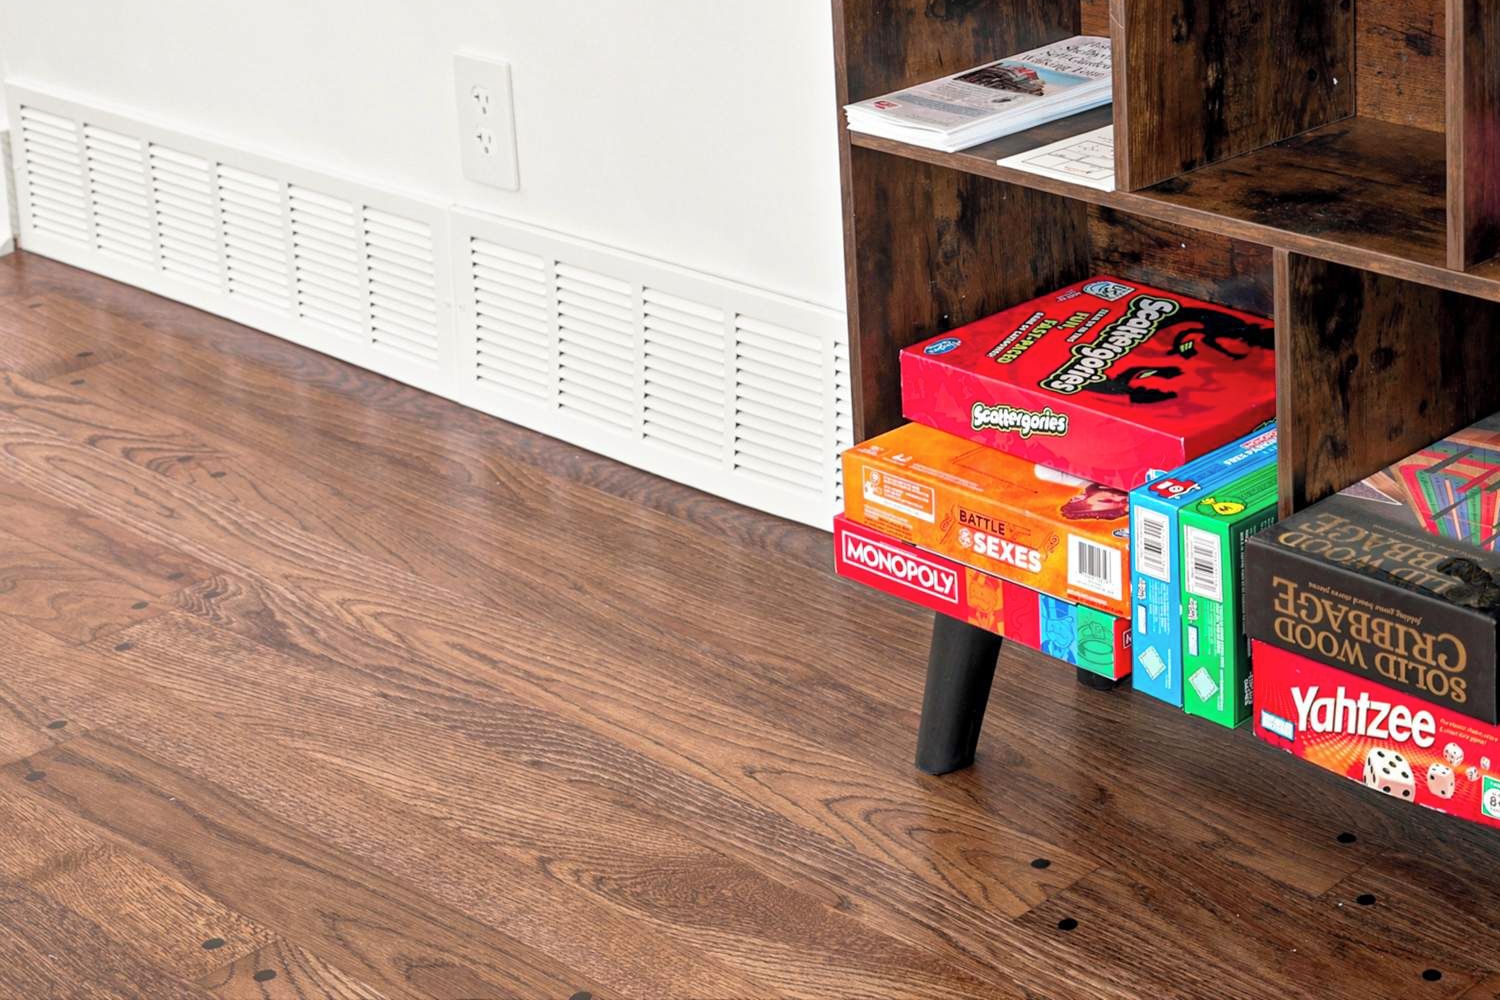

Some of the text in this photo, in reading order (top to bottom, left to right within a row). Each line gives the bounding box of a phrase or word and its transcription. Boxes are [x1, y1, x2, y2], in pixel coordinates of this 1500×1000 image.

[996, 319, 1059, 364] FAST-PACED
[1049, 298, 1174, 393] Scattergories
[972, 403, 1068, 435] Scattergories
[958, 509, 1006, 536] BATTLE
[845, 538, 956, 595] MONOPOLY
[972, 531, 1043, 574] SEXES
[1278, 531, 1384, 574] WOOD
[1272, 576, 1468, 674] CRIBBAGE
[1274, 617, 1369, 670] WOOD
[1374, 652, 1468, 704] SOLID
[1289, 685, 1437, 749] Yahtzee
